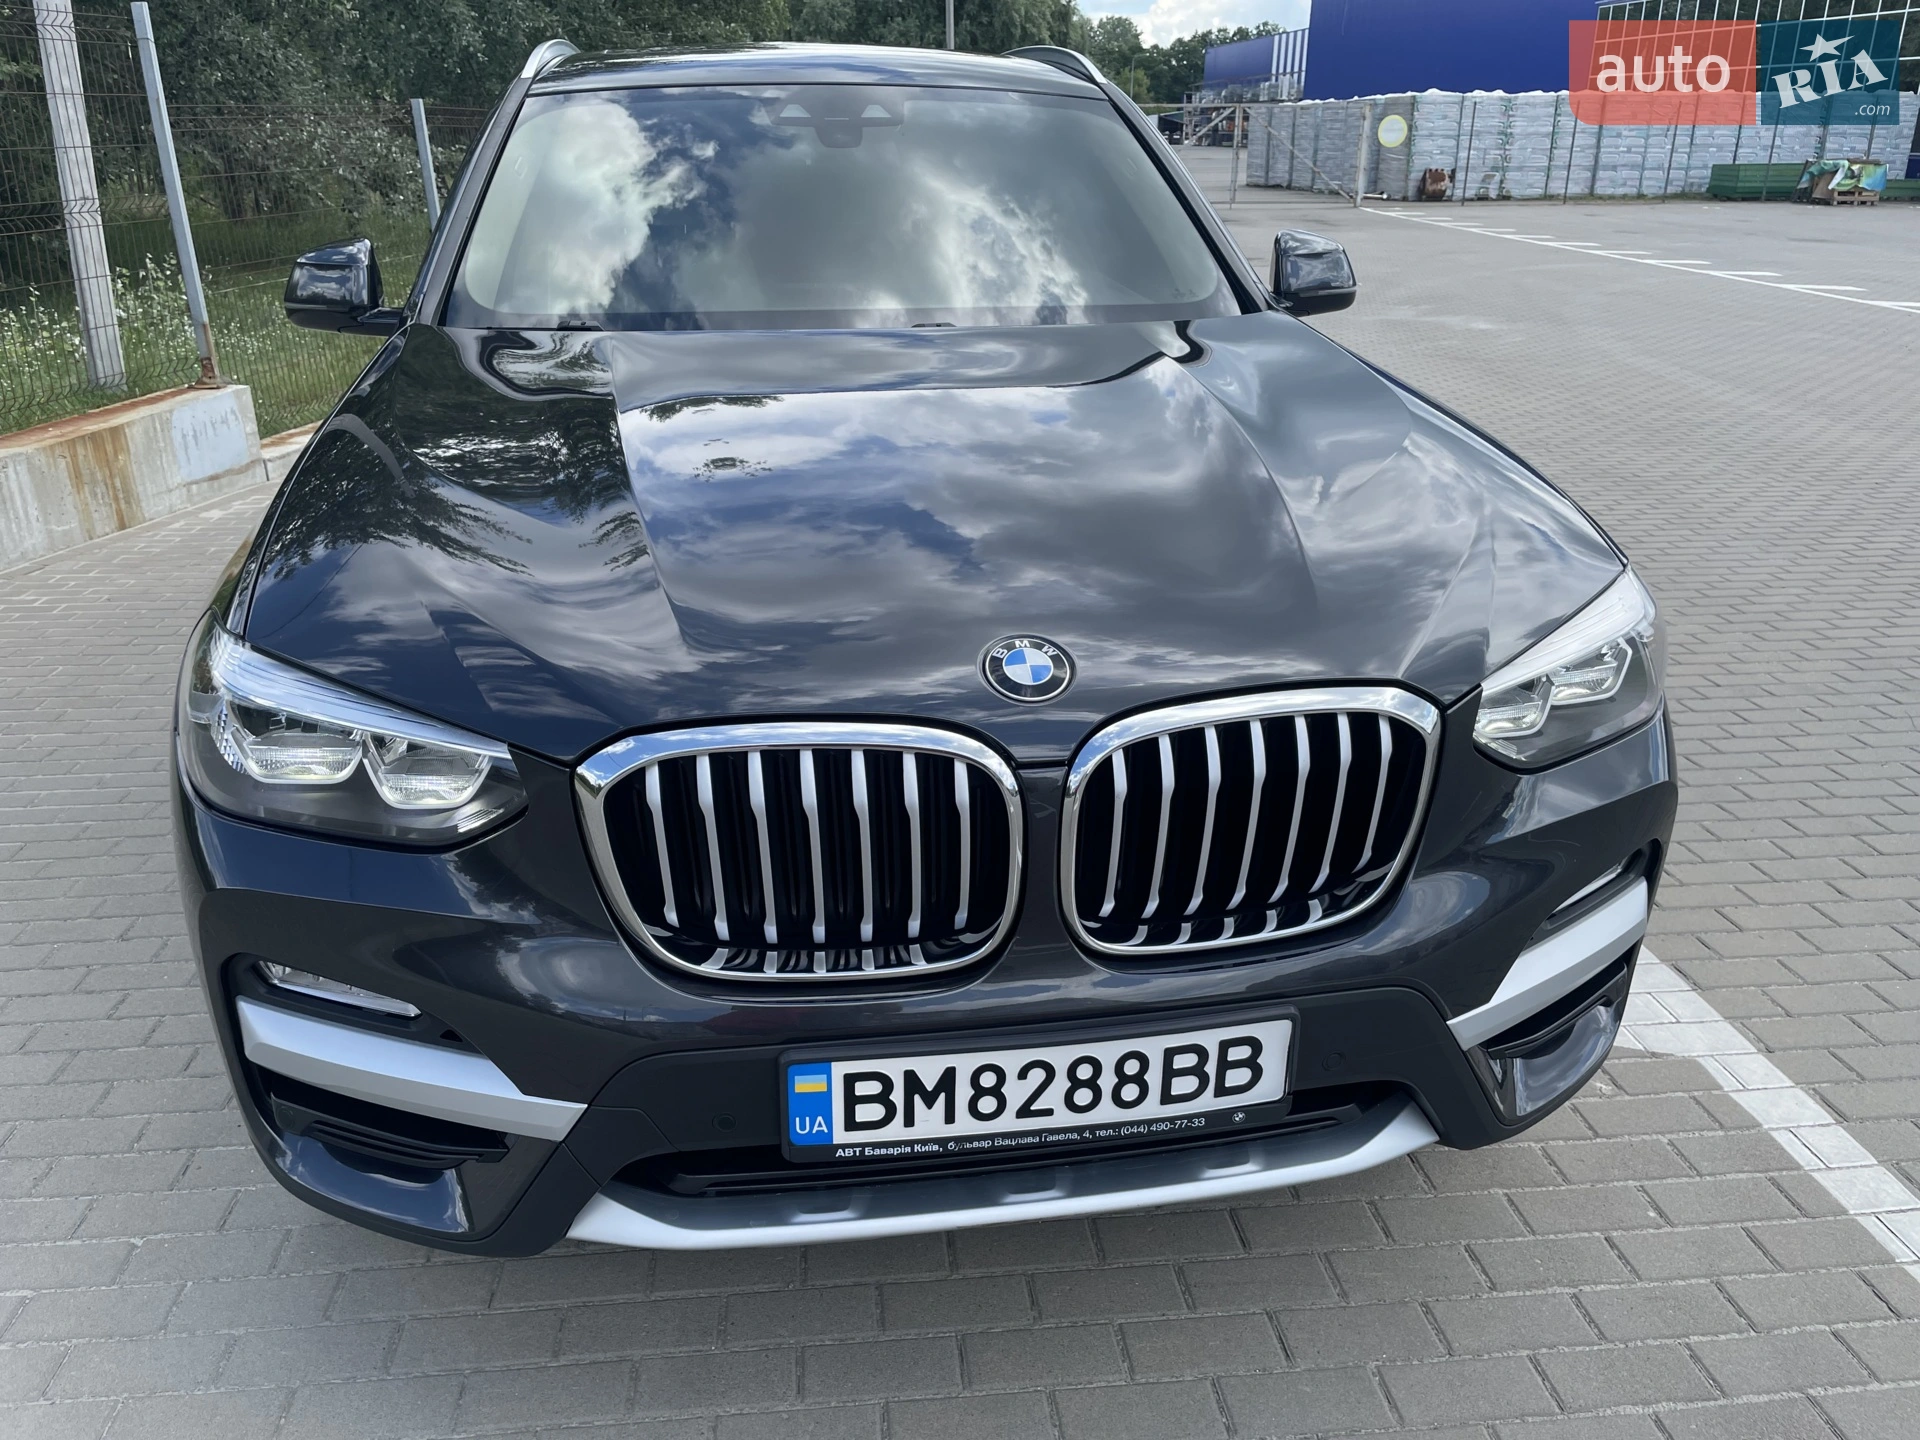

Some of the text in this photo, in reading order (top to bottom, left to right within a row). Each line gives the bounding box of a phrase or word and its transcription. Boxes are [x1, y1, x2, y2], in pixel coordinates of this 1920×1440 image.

[992, 640, 1058, 659] BMW
[843, 1035, 1264, 1132] BM8288BB
[795, 1116, 828, 1134] UA
[865, 1145, 911, 1156] Баварія
[994, 1135, 1040, 1147] Вацлава
[1121, 1124, 1148, 1136] (044)
[1150, 1117, 1206, 1132] 490-77-33
